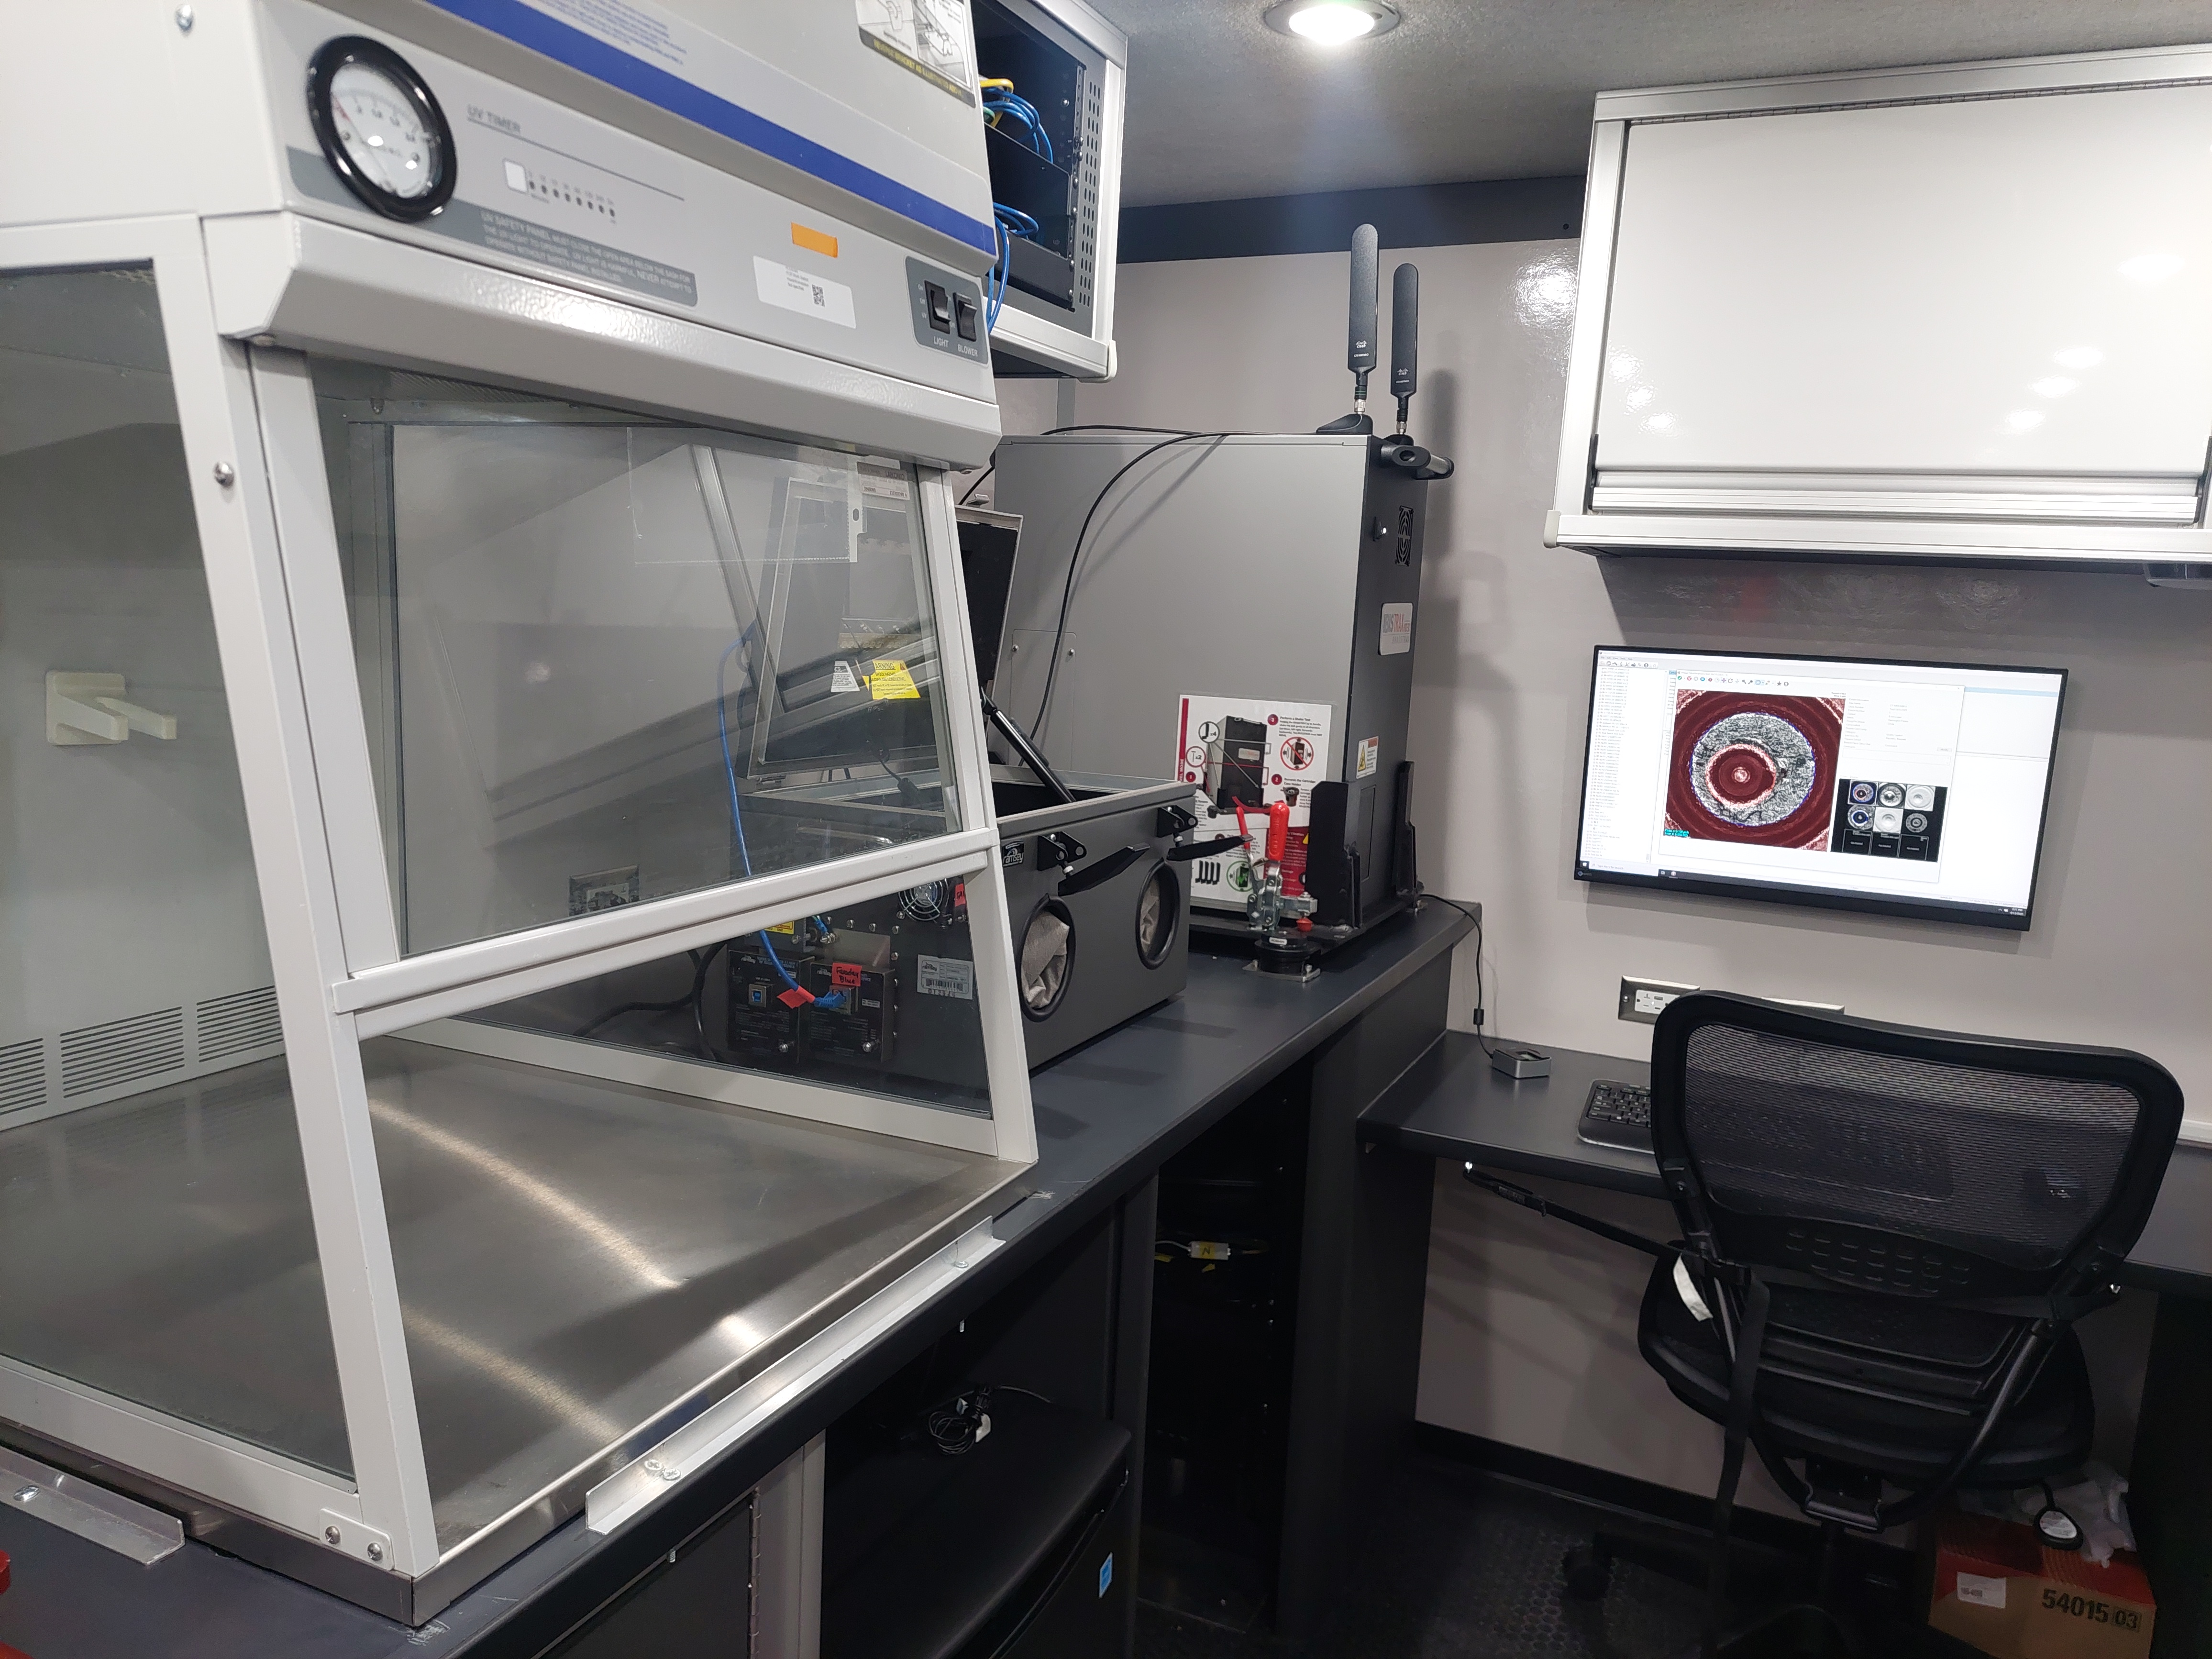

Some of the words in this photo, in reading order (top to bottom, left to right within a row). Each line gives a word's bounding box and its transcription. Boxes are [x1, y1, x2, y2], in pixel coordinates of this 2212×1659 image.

[636, 269, 660, 284] NEVER
[933, 336, 949, 348] LIGHT
[958, 344, 978, 357] BLOWER
[1003, 853, 1024, 864] ramsey
[836, 966, 859, 978] Faraday
[839, 975, 855, 984] Blue
[2041, 1588, 2110, 1624] 54015
[2114, 1608, 2139, 1630] 03
